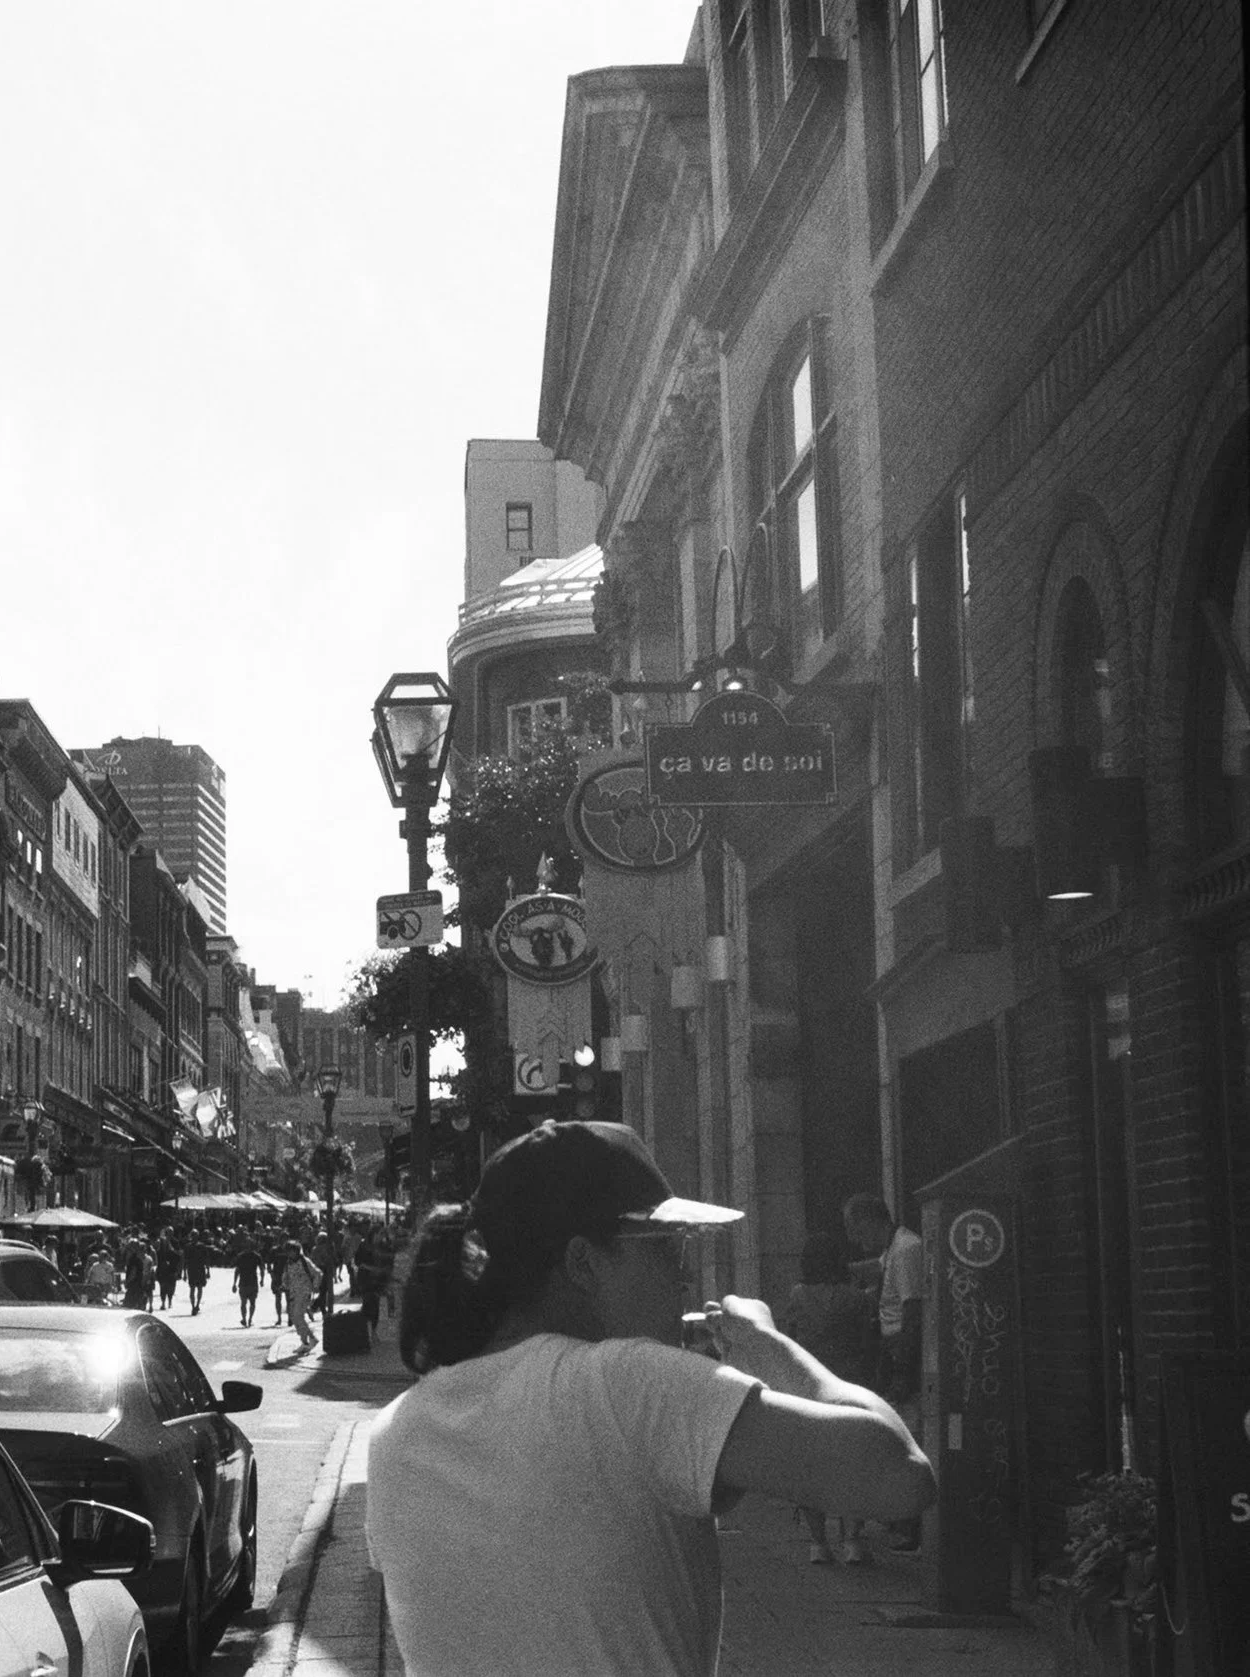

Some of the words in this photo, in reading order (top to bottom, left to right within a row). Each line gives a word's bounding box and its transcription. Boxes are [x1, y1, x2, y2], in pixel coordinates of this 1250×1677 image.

[659, 755, 692, 780] ça
[701, 755, 732, 773] va
[742, 751, 774, 772] de
